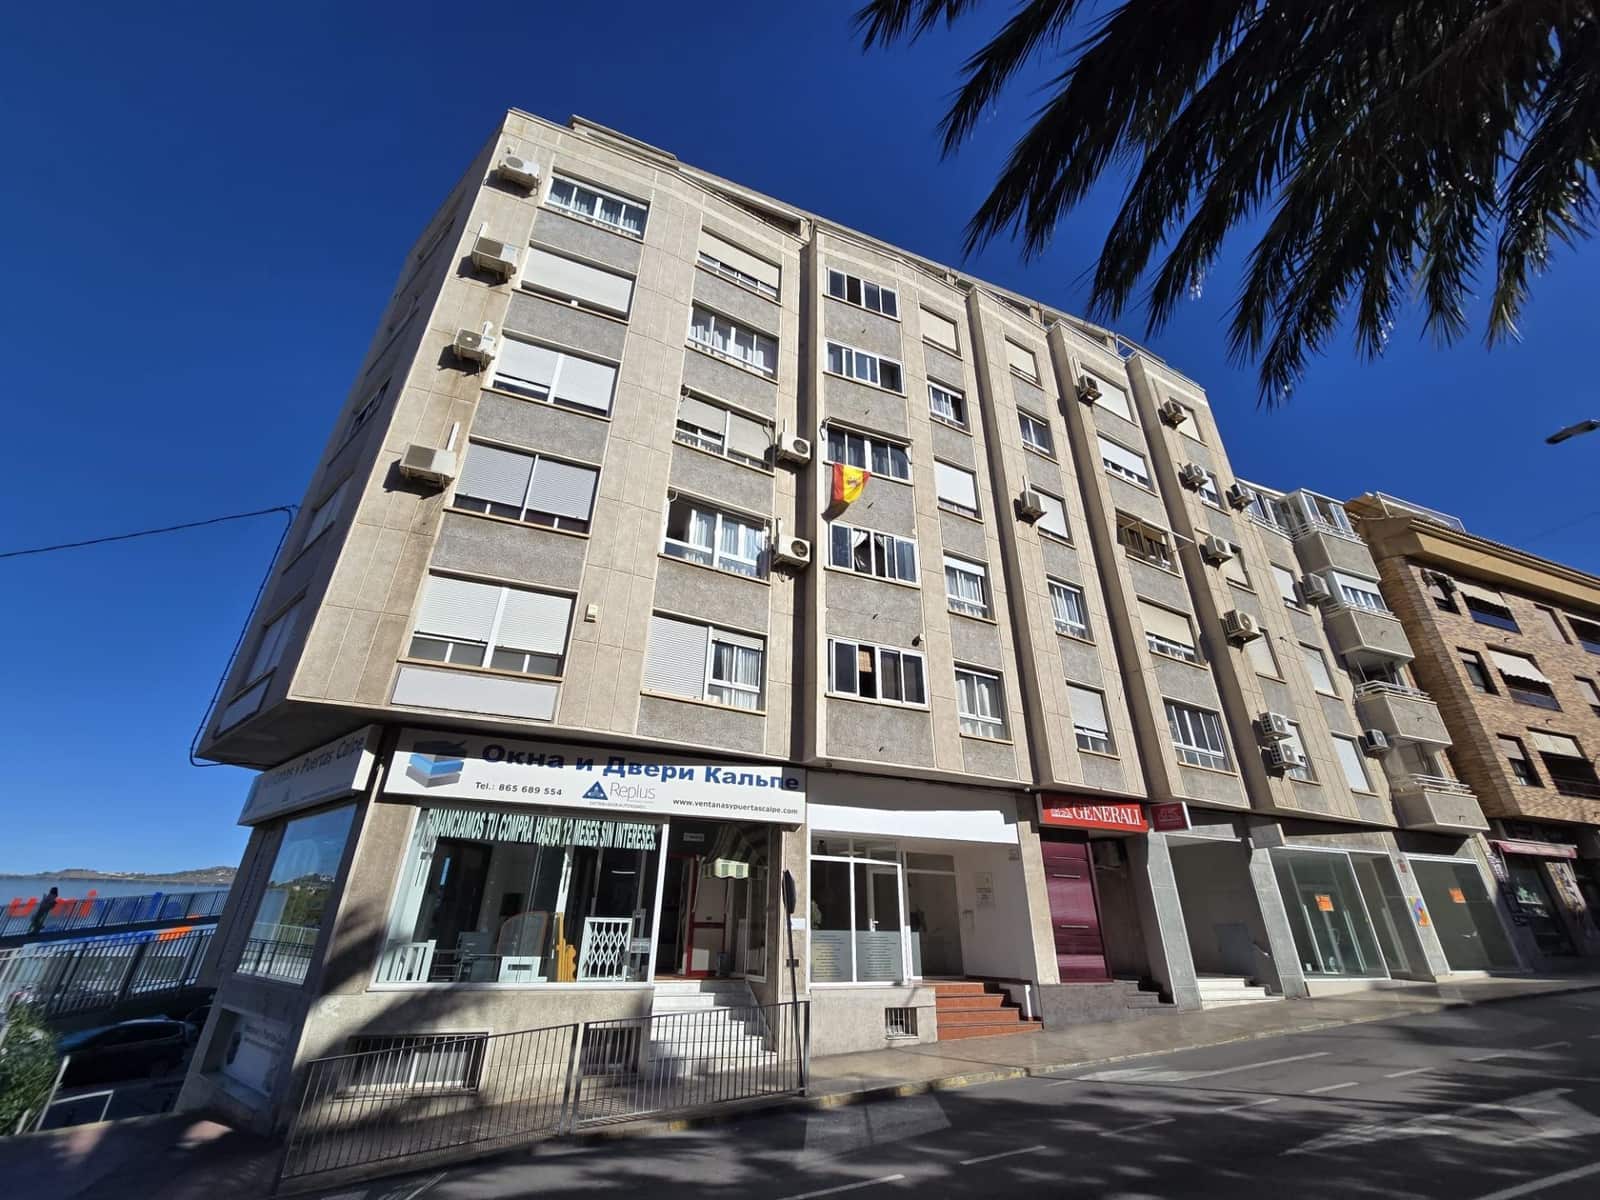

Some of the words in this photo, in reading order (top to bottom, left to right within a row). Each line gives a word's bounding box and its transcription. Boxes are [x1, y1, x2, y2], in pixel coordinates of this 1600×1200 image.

[481, 744, 565, 769] Окна
[575, 756, 593, 771] и
[602, 755, 694, 782] Двери
[705, 766, 800, 790] Кальпе
[475, 781, 495, 791] Tel.:
[498, 783, 518, 793] 865
[521, 785, 541, 794] 689
[543, 787, 563, 796] 554
[609, 781, 656, 801] Replus
[1072, 803, 1142, 826] GENERALI
[428, 808, 486, 839] FINANCIAMOS
[485, 812, 500, 840] TU
[498, 814, 534, 843] COMPRA
[532, 815, 562, 847] HASTA
[561, 817, 574, 847] 12
[573, 819, 600, 846] MESES
[599, 821, 615, 848] SIN
